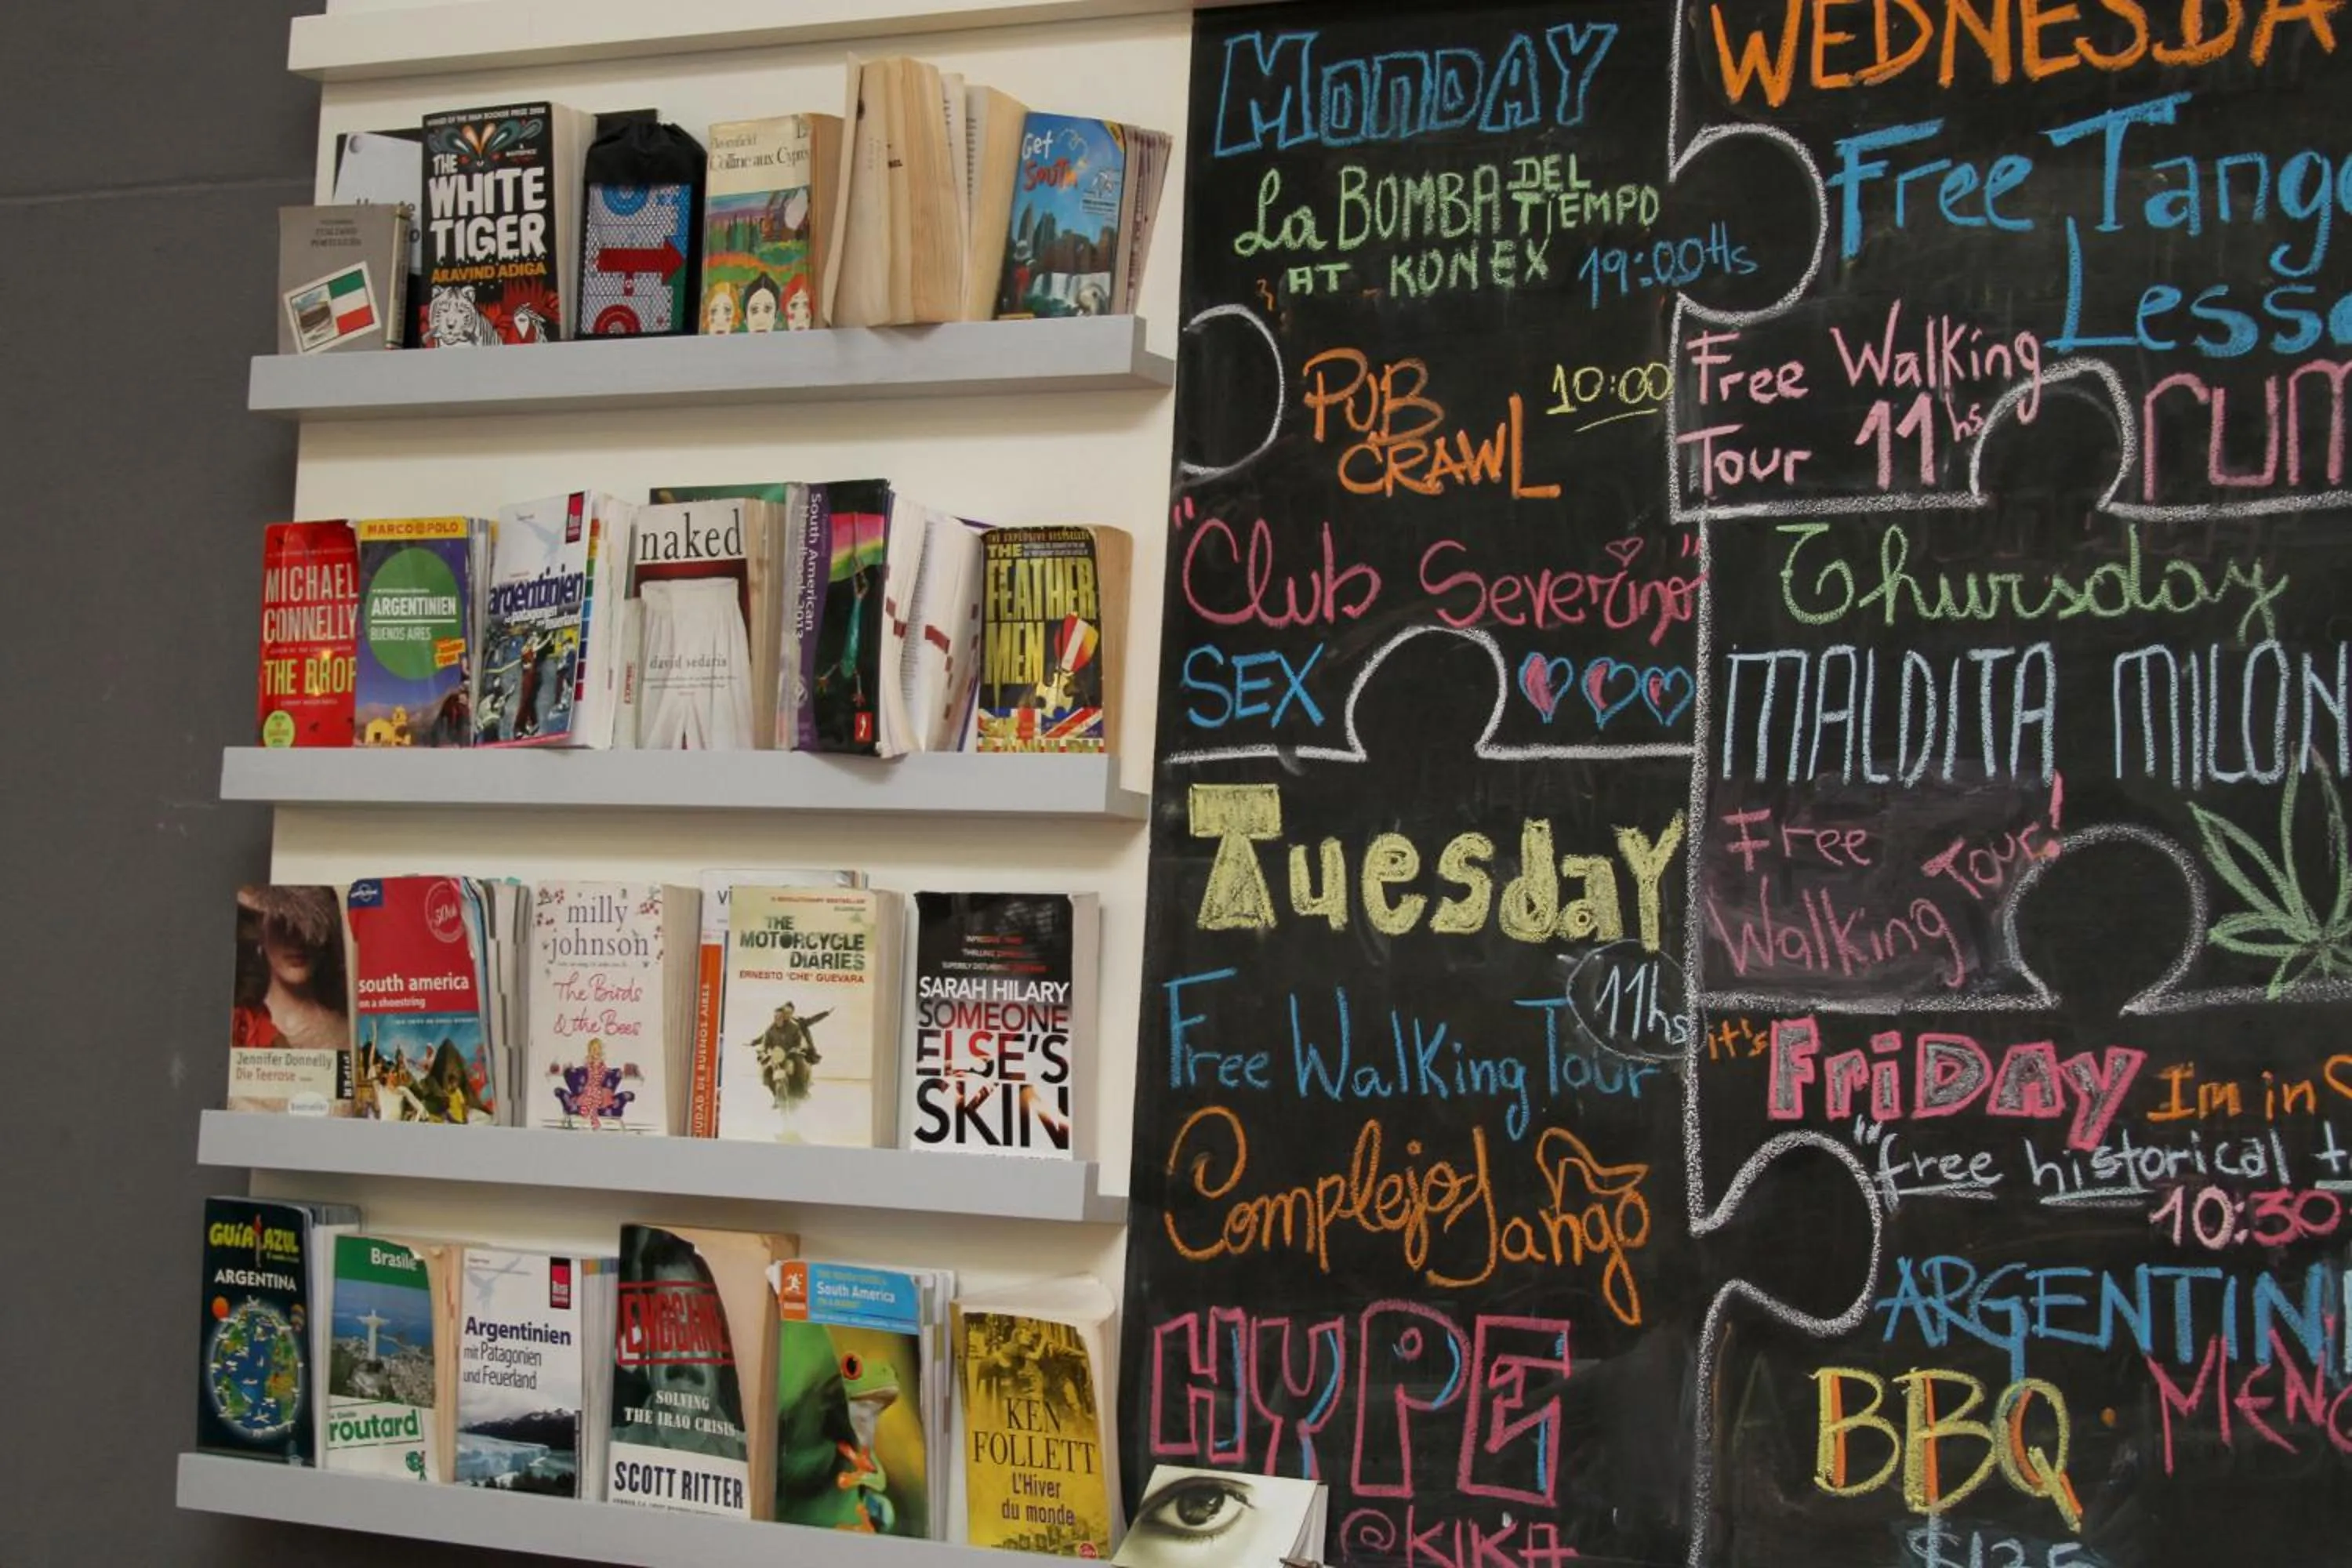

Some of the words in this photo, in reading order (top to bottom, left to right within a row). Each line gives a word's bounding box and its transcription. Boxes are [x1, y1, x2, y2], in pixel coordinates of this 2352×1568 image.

[1022, 129, 1053, 160] Get
[433, 153, 459, 176] THE
[1508, 154, 1592, 193] DEL
[428, 167, 546, 219] WHITE
[1827, 118, 2034, 260] Free
[1232, 168, 1328, 258] La
[1337, 165, 1503, 252] BOMBA
[430, 212, 547, 261] TIGER
[431, 263, 495, 284] ARAVIND
[498, 260, 547, 278] ADIGA
[1288, 263, 1351, 296] AT
[1389, 239, 1552, 298] KONEX
[1687, 330, 1809, 405] Free
[1304, 348, 1443, 443] PUB
[1546, 364, 1674, 416] 10:00
[1338, 394, 1562, 498] CRAWL
[1677, 423, 1812, 497] Tour
[367, 523, 413, 537] MARCO
[426, 521, 459, 534] POLO
[641, 508, 742, 561] naked
[808, 493, 822, 543] South
[987, 543, 1022, 558] THE
[265, 563, 358, 603] MICHAEL
[488, 563, 584, 615] argentinien
[805, 548, 818, 631] American
[986, 556, 1097, 621] FEATHER
[1777, 523, 2290, 647] Thursday
[263, 603, 358, 644] CONNELLY
[371, 596, 457, 616] ARGENTINIEN
[369, 626, 405, 641] BUENOS
[649, 655, 682, 669] david
[687, 653, 727, 667] sedaris
[985, 621, 1045, 686] MEN
[264, 658, 297, 696] THE
[1182, 641, 1324, 728] SEX
[1723, 640, 2058, 788] MALDITA
[1722, 807, 1871, 871] Free
[567, 895, 629, 933] milly
[765, 915, 795, 931] THE
[548, 927, 649, 964] johnson
[739, 930, 866, 952] MOTORCYCLE
[739, 970, 783, 981] ERNESTO
[816, 972, 866, 984] GUEVARA
[789, 951, 866, 971] DIARIES
[358, 972, 405, 993] south
[408, 971, 470, 992] america
[553, 971, 588, 1002] The
[590, 973, 643, 1003] Birds
[701, 983, 710, 1018] AIRES
[919, 976, 986, 1001] SARAH
[993, 979, 1069, 1004] HILARY
[358, 999, 370, 1008] on
[371, 999, 377, 1007] a
[378, 996, 426, 1010] shoestring
[553, 1012, 573, 1036] &
[572, 1006, 601, 1033] the
[600, 1008, 641, 1036] Bees
[918, 999, 1069, 1034] SOMEONE
[698, 1022, 708, 1071] BUENOS
[1163, 968, 1271, 1091] Free
[1514, 997, 1661, 1099] Tour
[235, 1067, 253, 1080] Die
[256, 1067, 296, 1082] Teerose
[236, 1051, 284, 1065] Jennifer
[285, 1052, 334, 1070] Donnelly
[916, 1028, 1069, 1084] ELSE'S
[1708, 1017, 1767, 1060] it's
[2146, 1062, 2242, 1121] Im
[2262, 1070, 2316, 1120] in
[697, 1076, 705, 1091] DE
[915, 1077, 1069, 1150] SKIN
[2024, 1126, 2291, 1196] historical
[2148, 1185, 2342, 1250] 10:30
[263, 1228, 300, 1254] AZUL
[213, 1268, 297, 1292] ARGENTINA
[816, 1281, 849, 1298] South
[851, 1284, 896, 1304] America
[464, 1316, 572, 1346] Argentinien
[1873, 1254, 2352, 1399] ARGENTIN
[463, 1346, 479, 1360] mit
[480, 1341, 543, 1368] Patagonien
[463, 1368, 481, 1384] und
[482, 1364, 537, 1391] Feuerland
[655, 1389, 710, 1411] SOLVING
[1006, 1396, 1062, 1434] KEN
[328, 1408, 419, 1442] routard
[624, 1406, 653, 1425] THE
[657, 1411, 691, 1430] IRAQ
[695, 1417, 737, 1437] CRISIS
[973, 1430, 1097, 1475] FOLLETT
[1810, 1366, 2082, 1534] BBQ
[614, 1461, 678, 1498] SCOTT
[681, 1470, 744, 1509] RITTER
[1012, 1471, 1062, 1500] L'Hiver
[1001, 1497, 1020, 1521] du
[1025, 1504, 1076, 1526] monde
